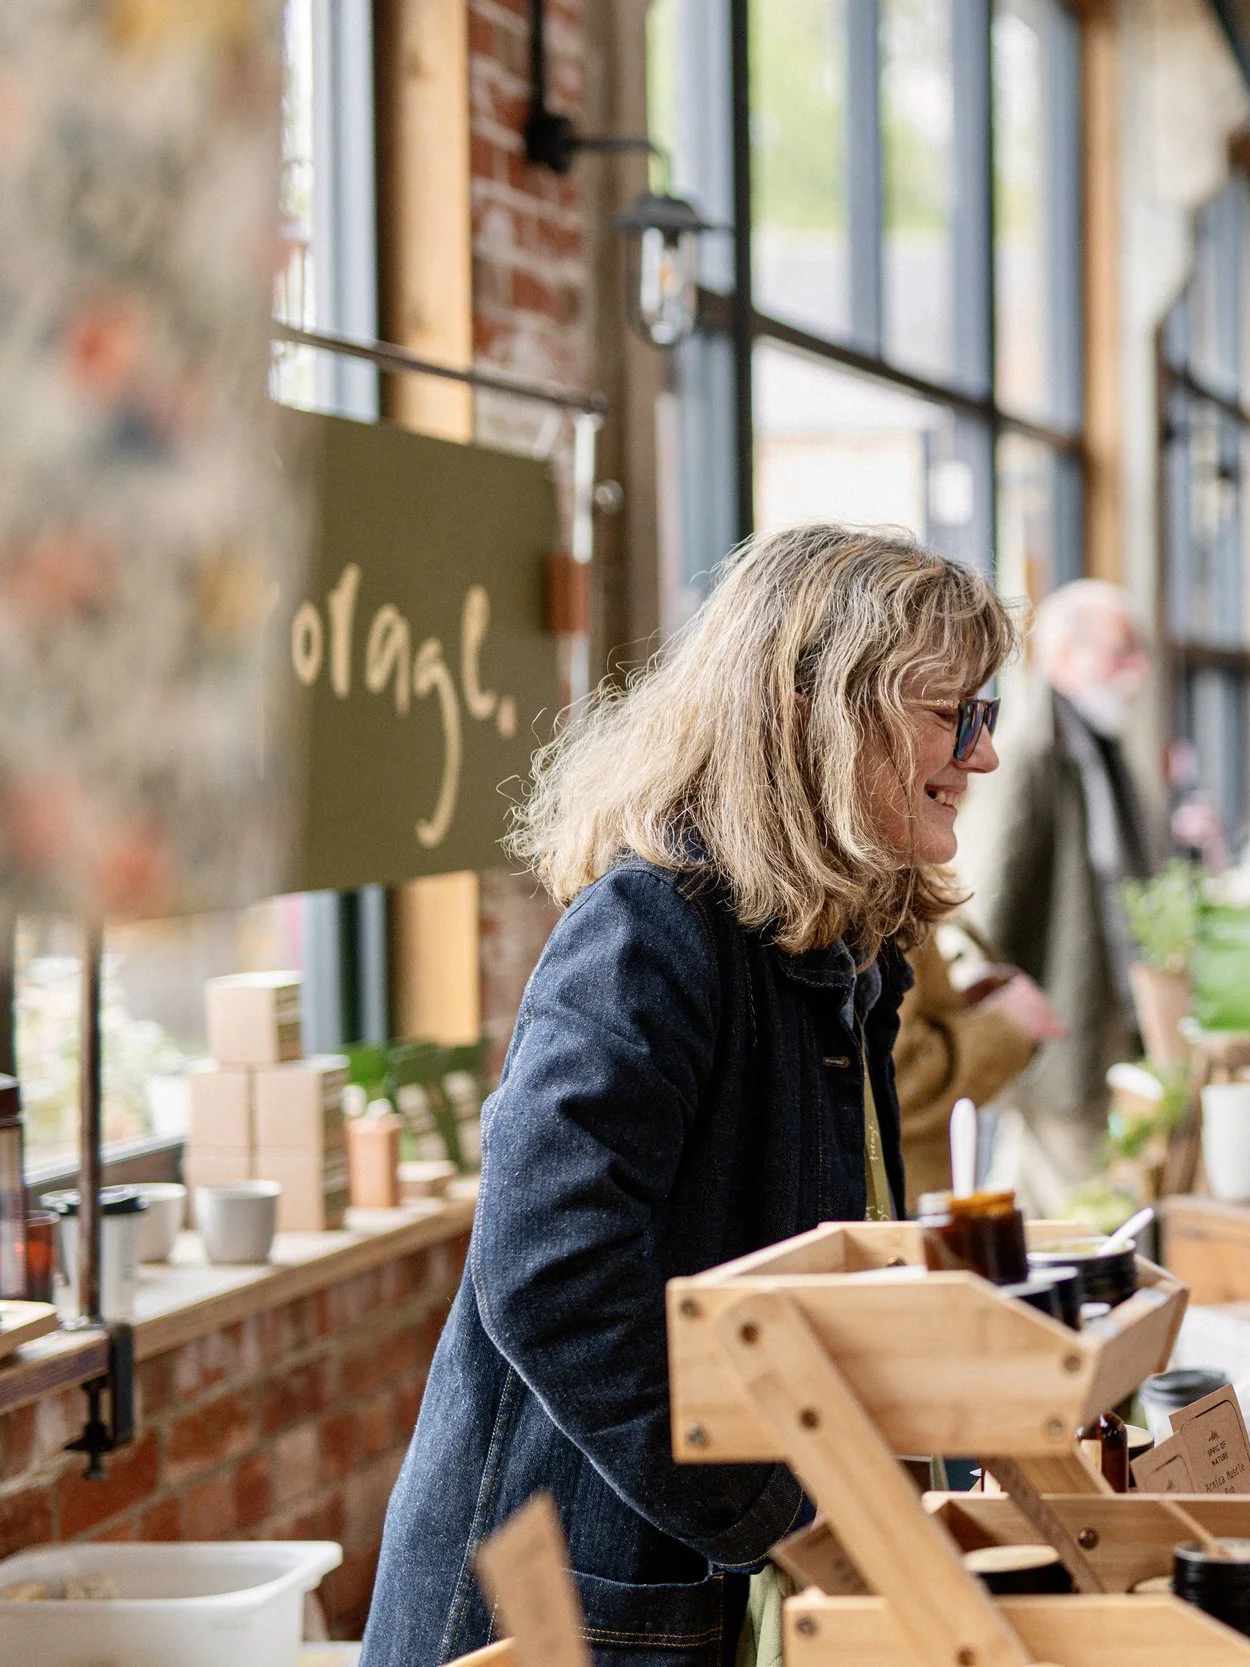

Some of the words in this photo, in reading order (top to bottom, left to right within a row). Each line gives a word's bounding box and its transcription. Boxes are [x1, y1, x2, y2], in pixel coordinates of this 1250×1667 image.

[1207, 1444, 1220, 1458] SPRIG
[1220, 1440, 1227, 1450] OF
[1211, 1451, 1229, 1467] NATURE
[1205, 1475, 1226, 1493] Arnica
[1226, 1463, 1245, 1480] Muscle
